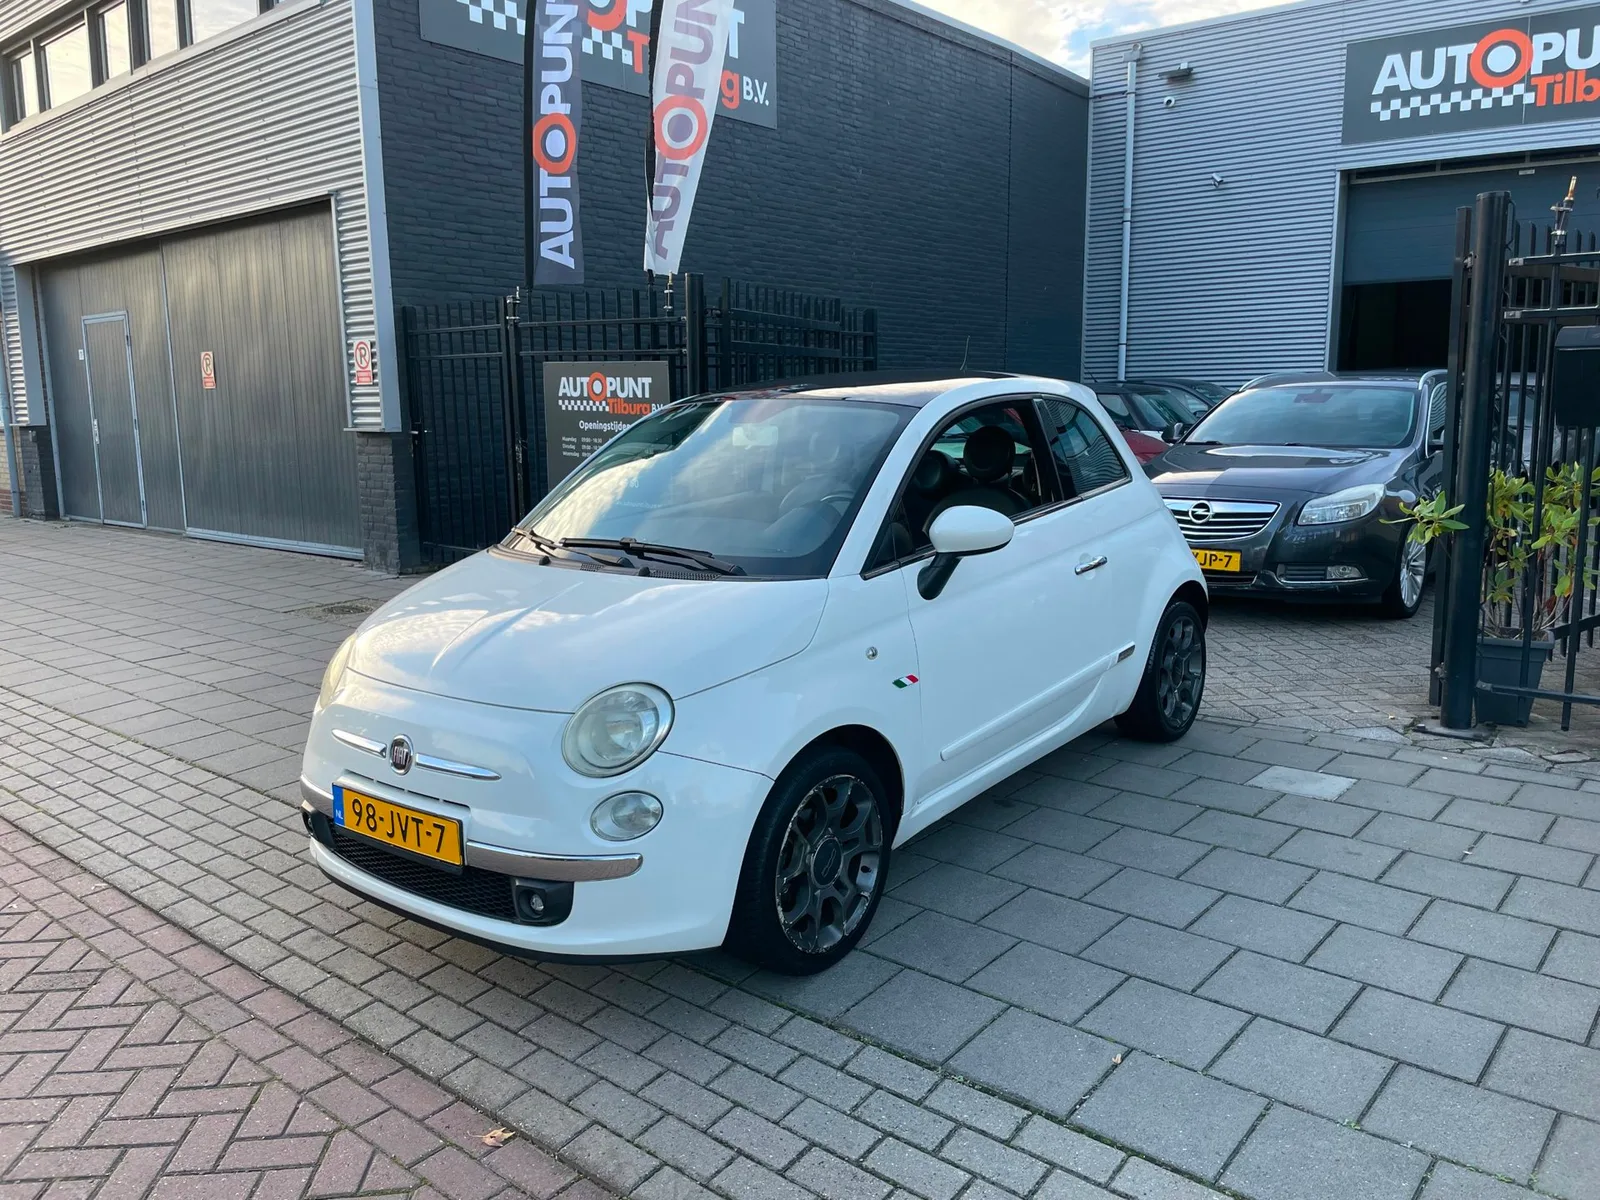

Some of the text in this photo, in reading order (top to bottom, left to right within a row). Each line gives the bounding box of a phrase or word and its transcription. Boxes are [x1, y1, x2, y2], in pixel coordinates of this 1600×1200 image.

[743, 75, 769, 107] B.V.
[1530, 70, 1600, 107] Tilb
[533, 0, 578, 269] AUTOPUN
[558, 372, 652, 402] AUTOPUNT
[393, 745, 408, 765] FIAT
[335, 809, 344, 820] NL
[351, 798, 446, 853] 98-JVT-7
